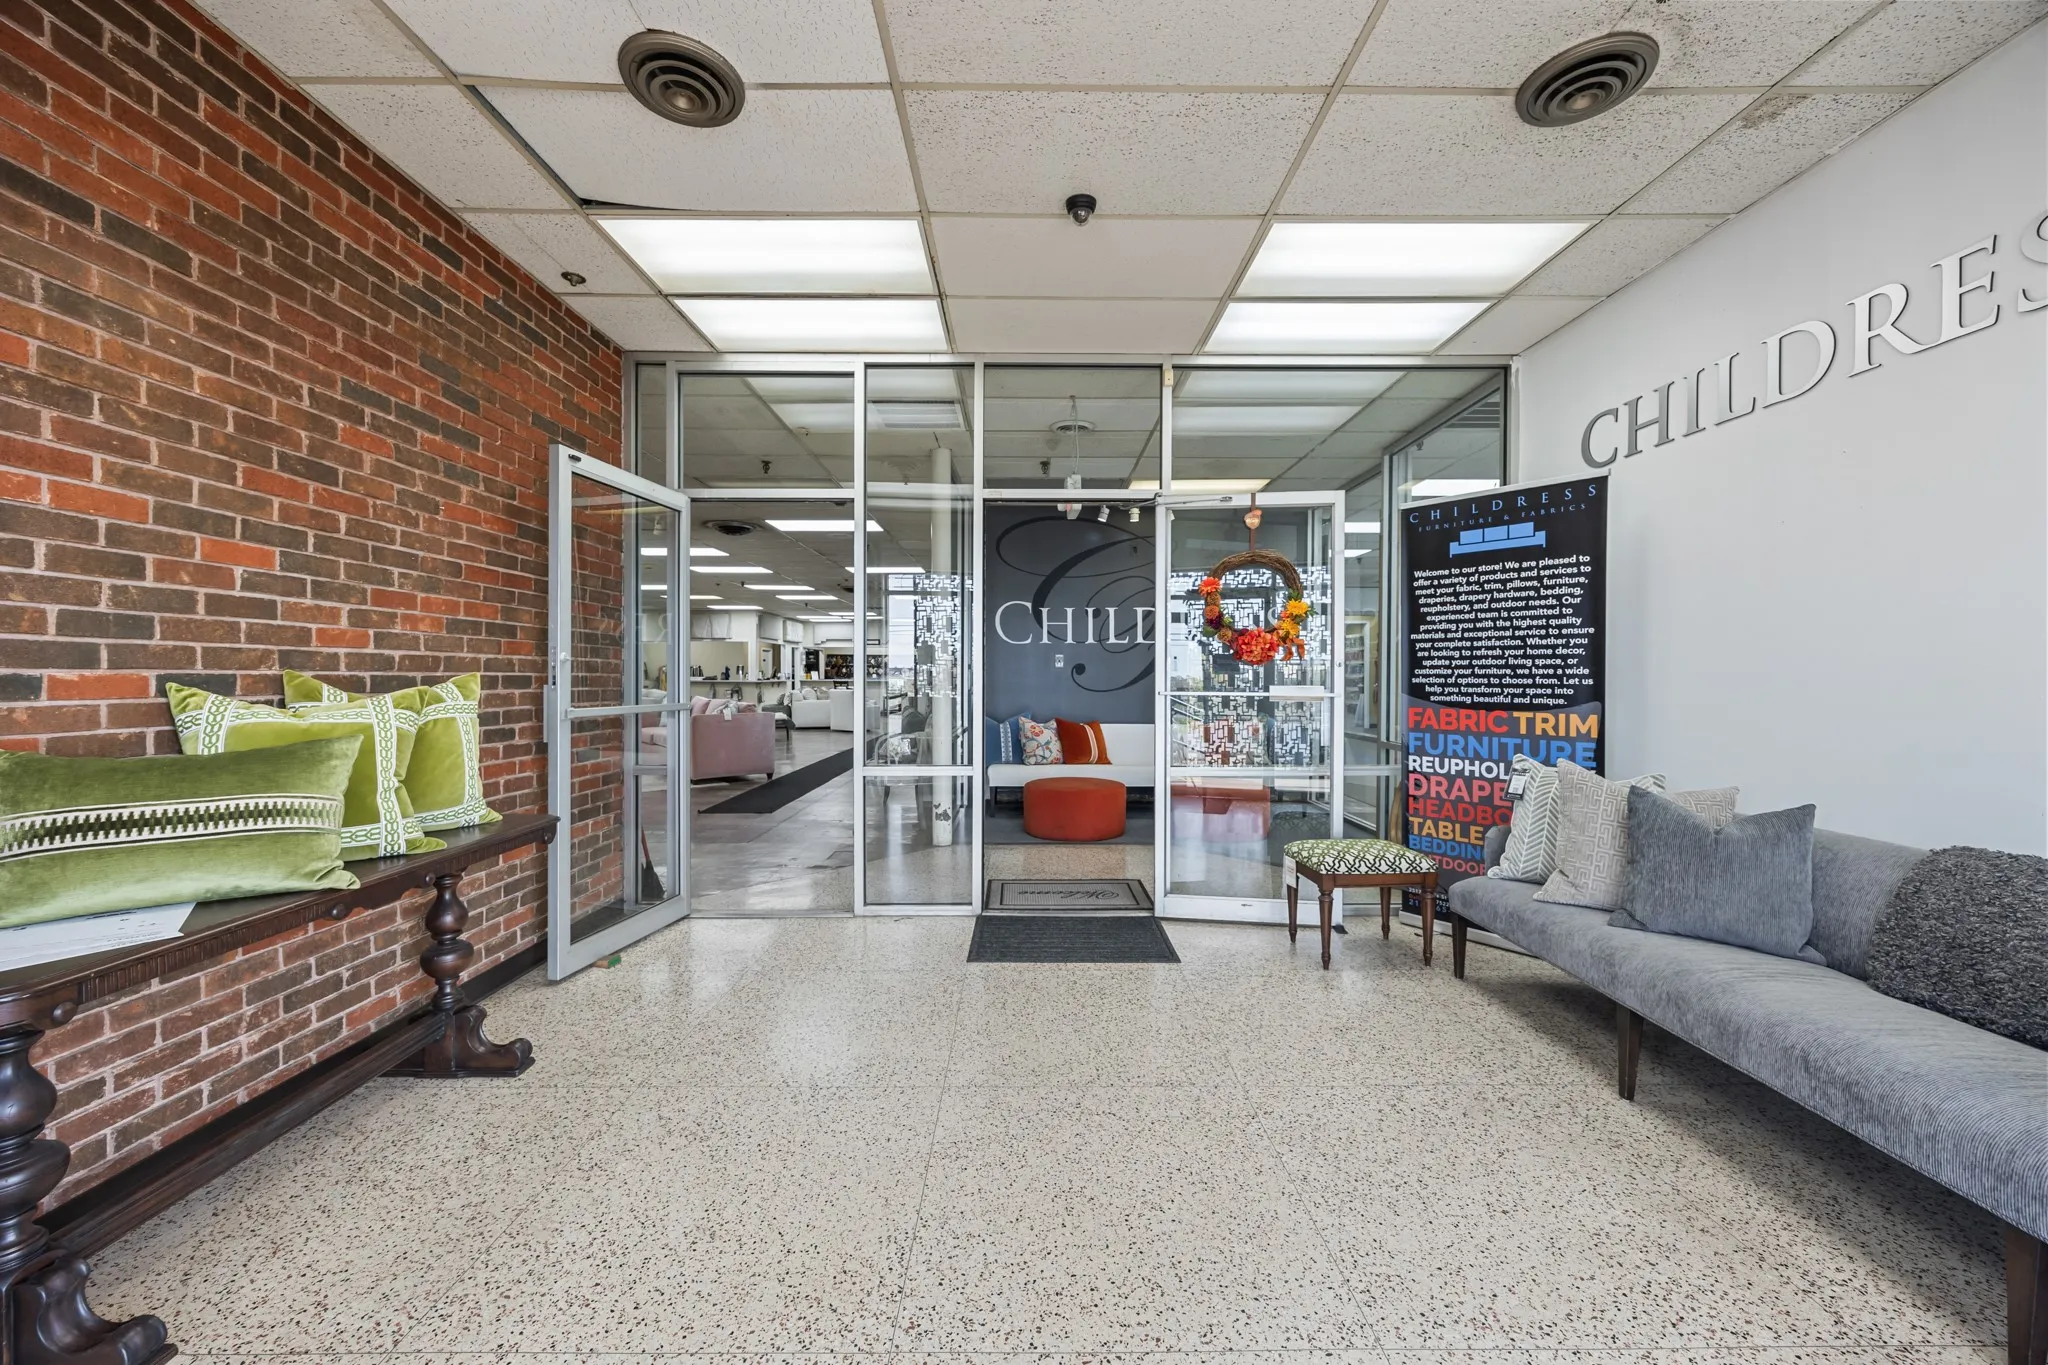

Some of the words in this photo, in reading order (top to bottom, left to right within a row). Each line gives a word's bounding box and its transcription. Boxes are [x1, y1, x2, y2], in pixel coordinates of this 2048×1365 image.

[1410, 484, 1596, 523] CHILDRESS
[1418, 516, 1493, 533] FURNITURE
[1521, 503, 1586, 518] FABRICS
[1413, 568, 1449, 577] Welcome
[1478, 562, 1502, 571] store!
[1538, 556, 1576, 568] pleased
[1413, 578, 1431, 586] offer
[1439, 576, 1467, 584] variety
[1468, 574, 1478, 582] of
[1480, 572, 1518, 583] products
[1520, 569, 1537, 578] and
[1539, 568, 1577, 576] services
[1415, 587, 1434, 595] meet
[1436, 587, 1454, 595] your
[1455, 584, 1481, 592] fabric,
[1506, 580, 1540, 590] pillows,
[1542, 577, 1588, 586] furniture,
[1418, 595, 1456, 604] draperies,
[1458, 593, 1491, 602] drapery
[1493, 590, 1537, 598] hardware,
[1540, 588, 1583, 596] bedding,
[1420, 604, 1470, 613] reupholstery,
[1472, 601, 1488, 609] and
[1490, 600, 1526, 608] outdoor
[1528, 598, 1559, 606] needs.
[1426, 611, 1475, 622] experienced
[1510, 607, 1559, 616] committed
[1419, 622, 1456, 632] providing
[1458, 622, 1473, 630] you
[1475, 620, 1493, 628] with
[1512, 618, 1546, 628] highest
[1548, 617, 1582, 627] quality
[1410, 631, 1445, 639] materials
[1446, 630, 1461, 638] and
[1463, 628, 1512, 638] exceptional
[1415, 642, 1432, 650] your
[1433, 640, 1471, 649] complete
[1526, 637, 1567, 645] Whether
[1568, 638, 1587, 646] you
[1430, 649, 1459, 658] looking
[1504, 649, 1524, 657] your
[1554, 647, 1585, 655] decor,
[1422, 658, 1449, 667] update
[1451, 659, 1470, 667] your
[1508, 658, 1532, 666] living
[1453, 668, 1472, 676] your
[1474, 667, 1513, 675] furniture,
[1456, 676, 1488, 685] options
[1534, 676, 1560, 684] from.
[1563, 676, 1579, 684] Let
[1425, 684, 1442, 693] help
[1429, 694, 1471, 703] something
[1473, 695, 1510, 703] beautiful
[1512, 696, 1530, 704] and
[1532, 697, 1567, 706] unique.
[1408, 707, 1508, 733] FABRIC
[1513, 711, 1599, 738] TRIM
[1408, 732, 1597, 768] FURNITURE
[1409, 817, 1484, 845] TABLE
[1409, 834, 1486, 860] BEDDIN
